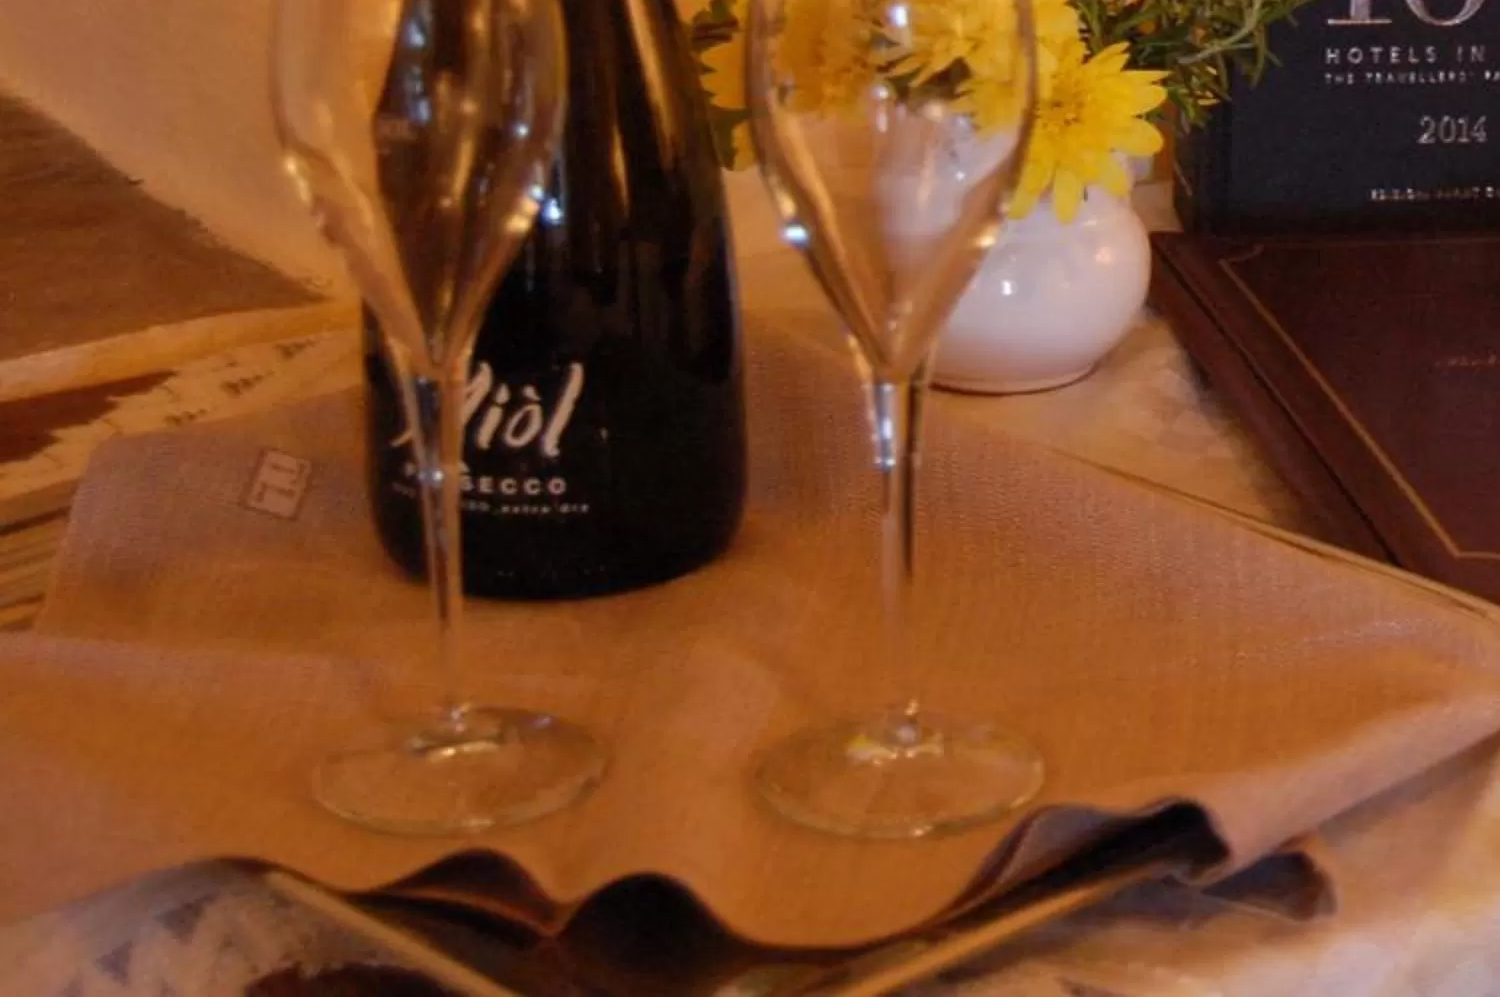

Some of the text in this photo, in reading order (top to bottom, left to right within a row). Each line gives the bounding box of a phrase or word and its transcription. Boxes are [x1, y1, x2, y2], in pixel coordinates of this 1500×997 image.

[1324, 45, 1437, 64] HOTELS
[1456, 44, 1485, 63] IN
[1416, 115, 1488, 145] 2014
